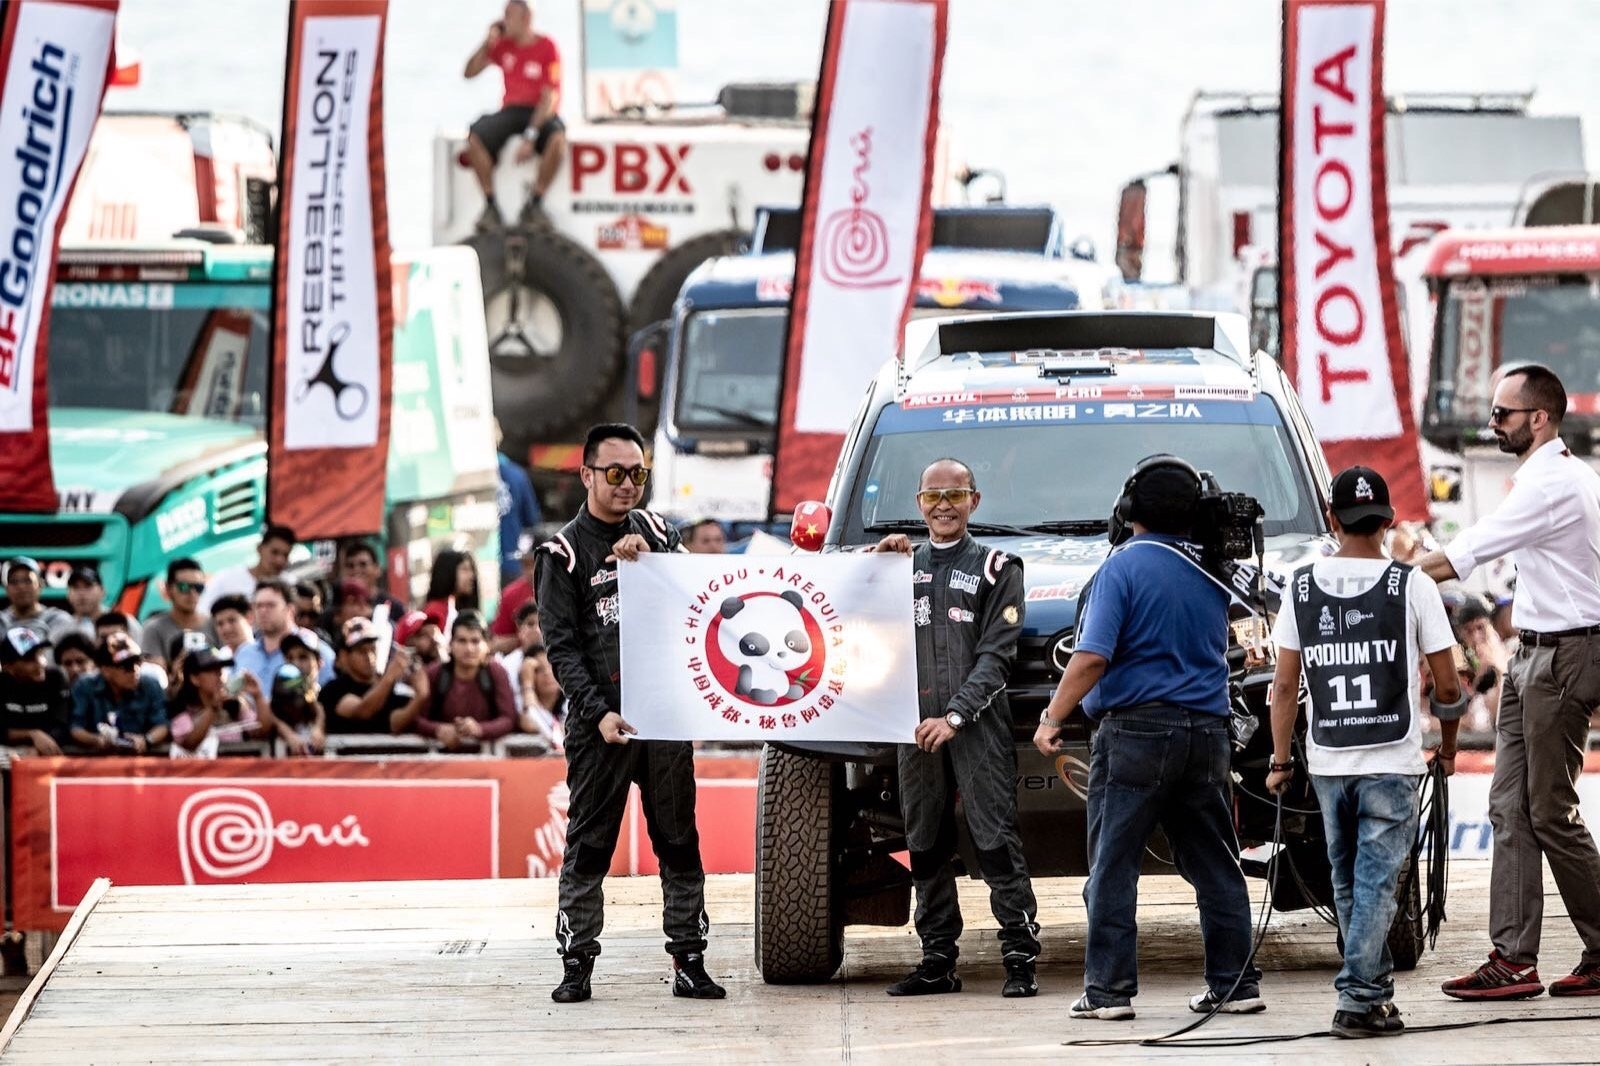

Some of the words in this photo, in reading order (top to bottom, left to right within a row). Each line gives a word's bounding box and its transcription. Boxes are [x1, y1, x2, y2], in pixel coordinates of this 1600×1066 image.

[572, 143, 691, 193] PBX
[1313, 45, 1370, 402] TOYOTA
[53, 284, 145, 306] RONAS
[908, 393, 977, 406] MOTUL
[1387, 566, 1402, 596] 2019
[685, 568, 748, 645] CHENGDU
[1304, 641, 1370, 668] PODIUM
[1372, 640, 1397, 663] TV
[1328, 674, 1377, 711] 11
[1343, 713, 1399, 726] #Dakar2019
